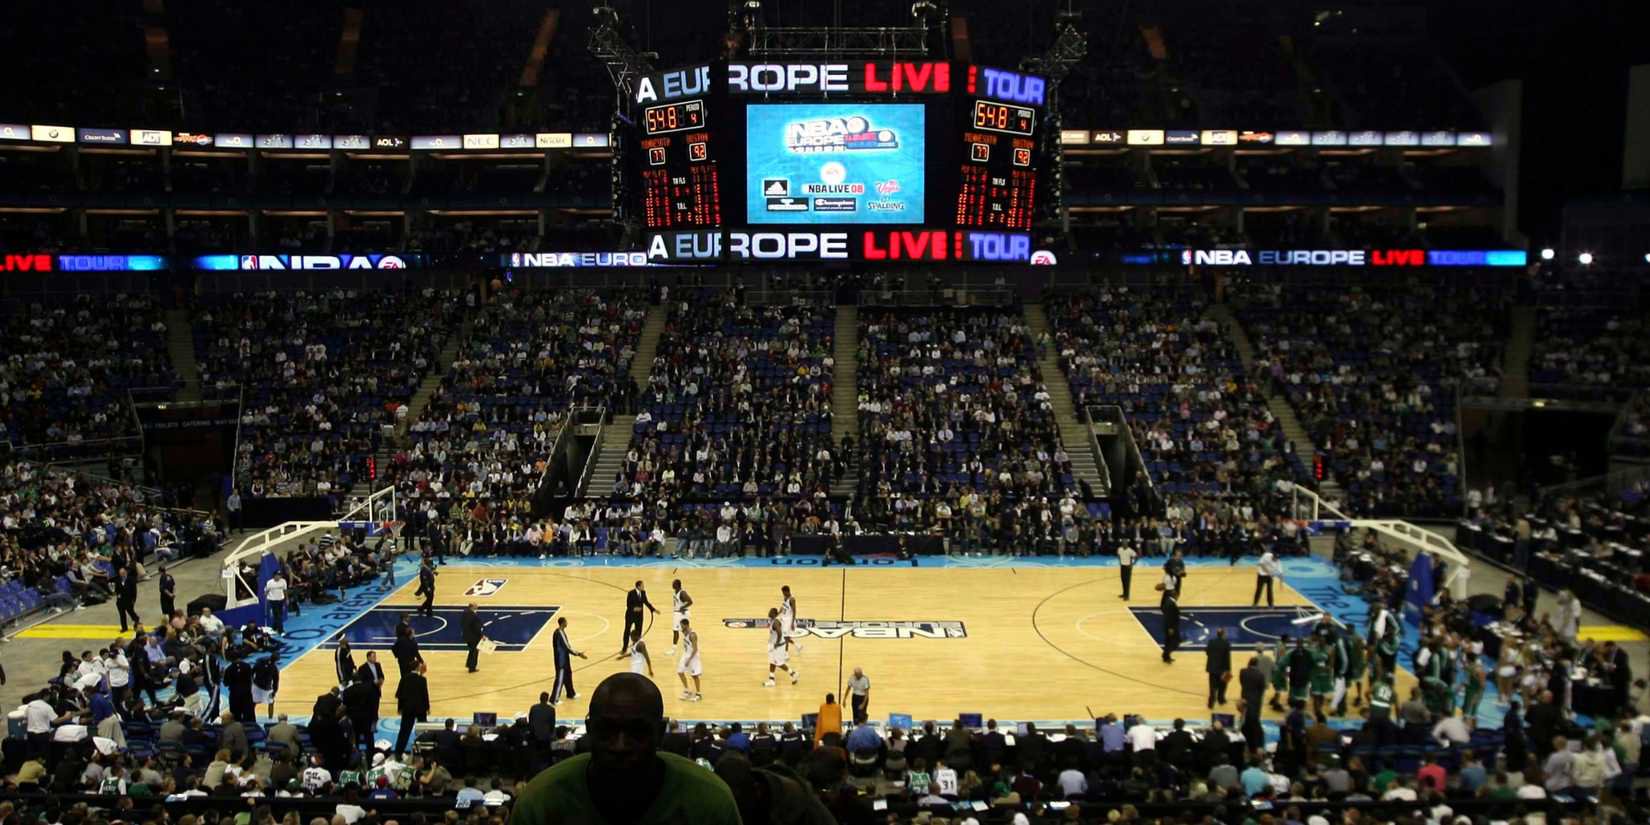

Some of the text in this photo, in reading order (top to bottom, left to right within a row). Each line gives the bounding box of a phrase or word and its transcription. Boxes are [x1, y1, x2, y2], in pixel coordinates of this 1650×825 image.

[984, 68, 1045, 105] TOUR
[690, 113, 697, 124] 4
[789, 118, 848, 143] NBA
[1094, 133, 1112, 142] AOL
[377, 138, 393, 147] AOL
[694, 145, 704, 158] 92
[1017, 151, 1029, 165] 92
[808, 184, 863, 193] NBA LIVE 08
[969, 232, 1030, 260] TOUR
[0, 254, 125, 271] IVE TOUR
[523, 252, 647, 267] NBA EURO
[1195, 249, 1252, 265] NBA
[1259, 250, 1365, 265] EUROPE
[1371, 249, 1425, 266] LIVE
[942, 780, 954, 791] 31
